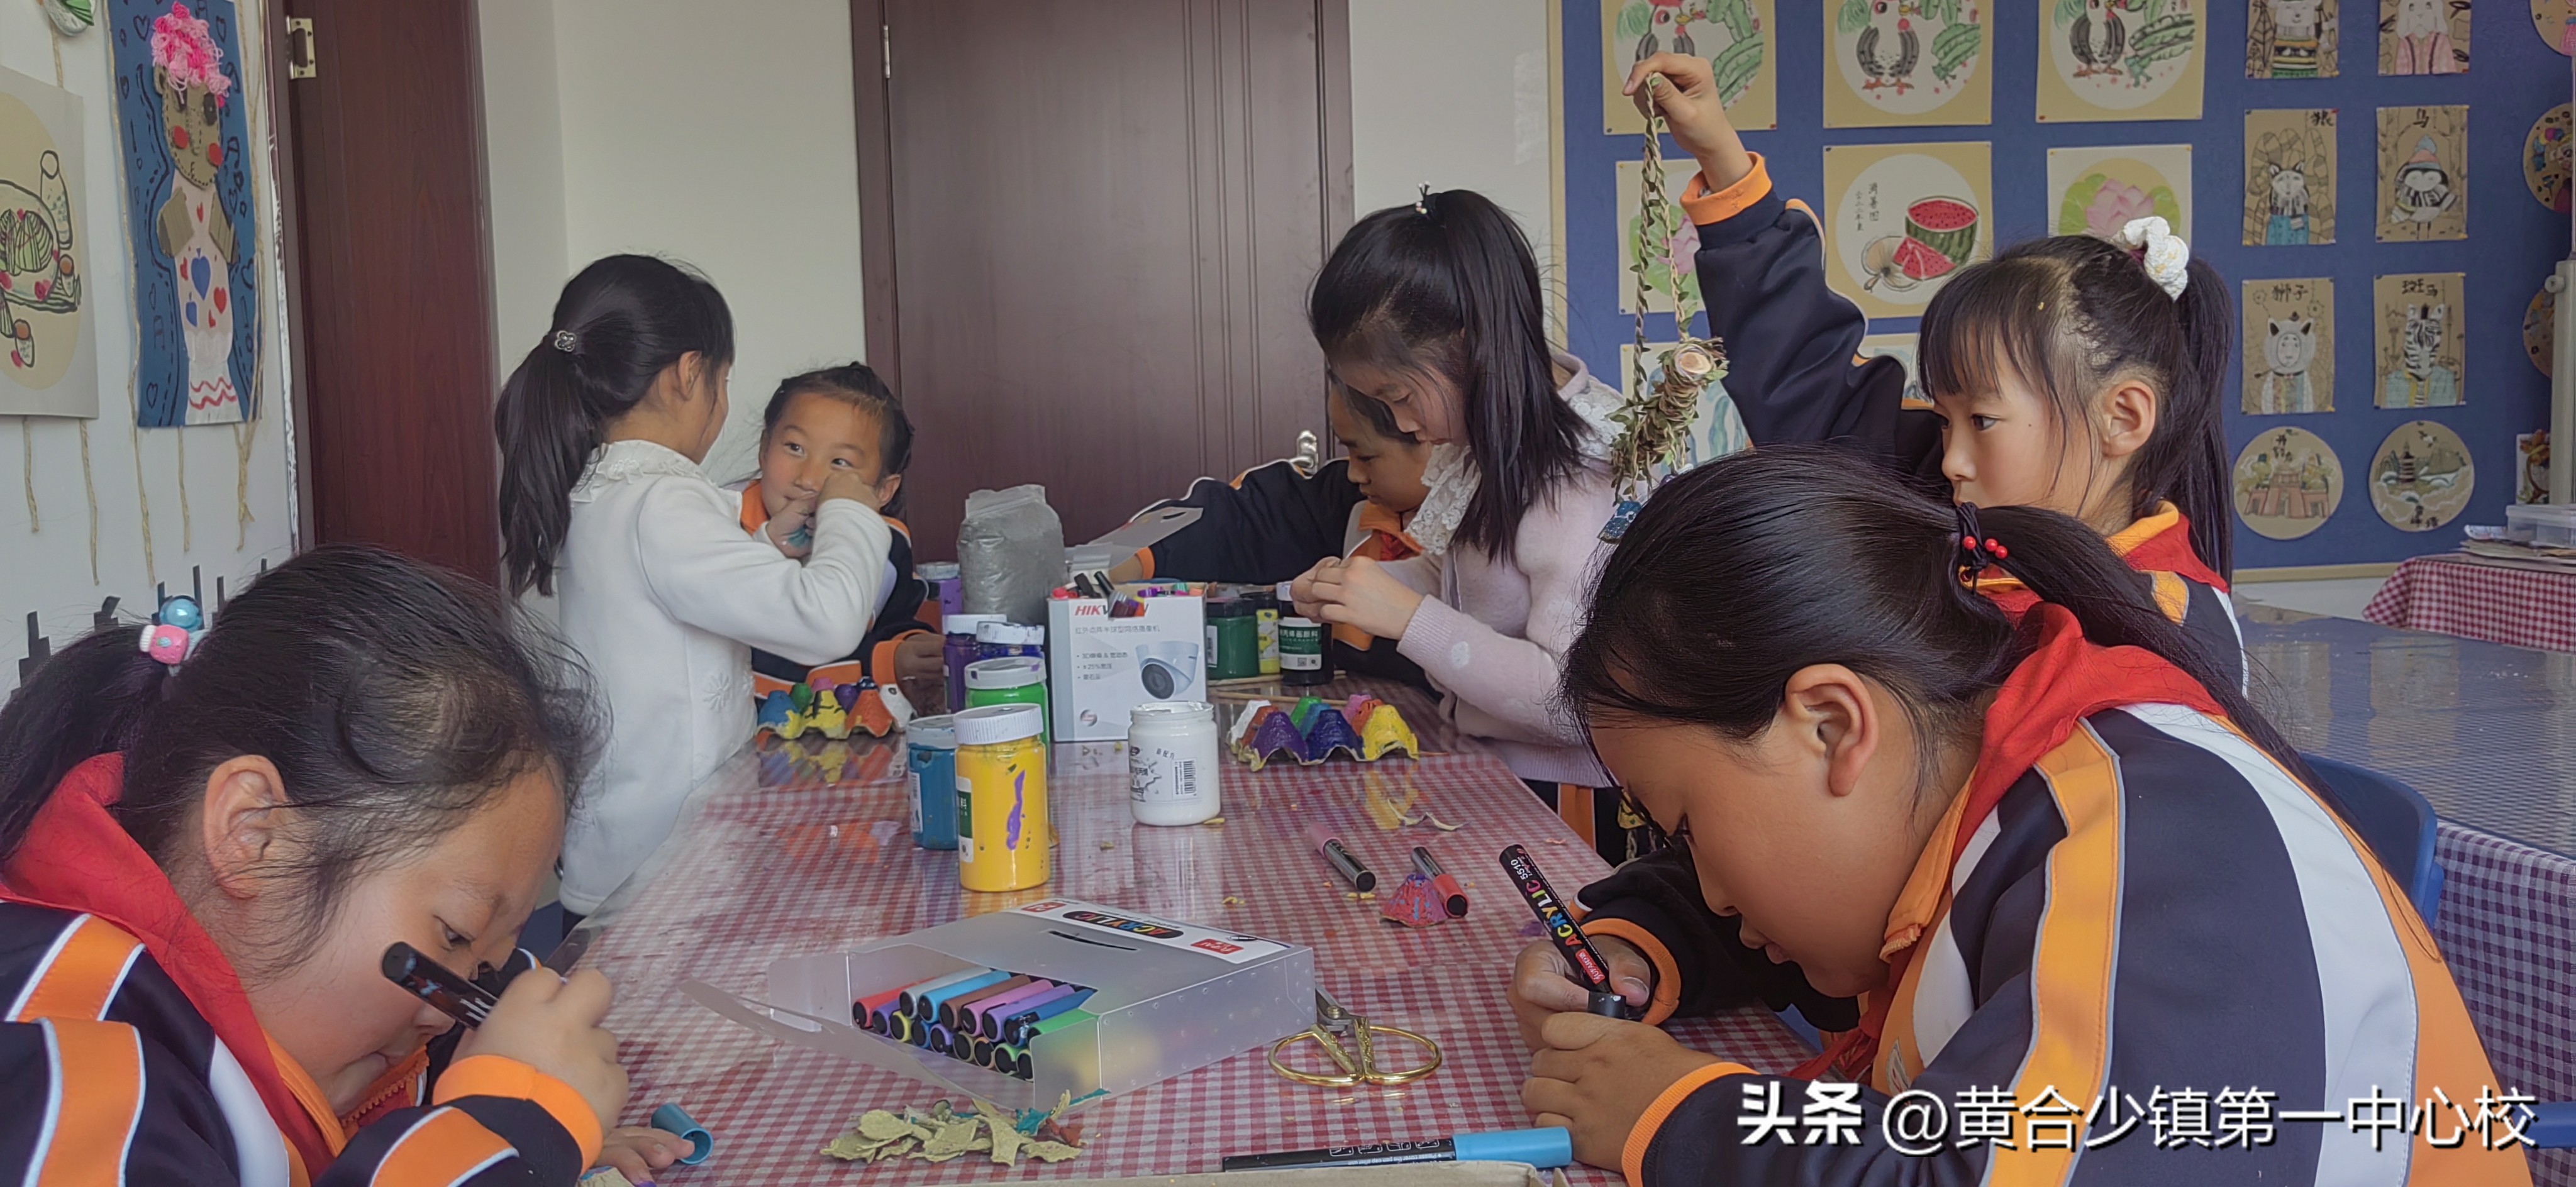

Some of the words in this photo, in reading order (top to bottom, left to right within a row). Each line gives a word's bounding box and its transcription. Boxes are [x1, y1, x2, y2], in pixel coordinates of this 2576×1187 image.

[2272, 283, 2309, 302] 狮子
[2401, 278, 2438, 297] 斑马
[1511, 859, 1529, 880] 5510
[1526, 880, 1583, 947] ACRYLIC
[1074, 913, 1174, 936] ACRYLIC
